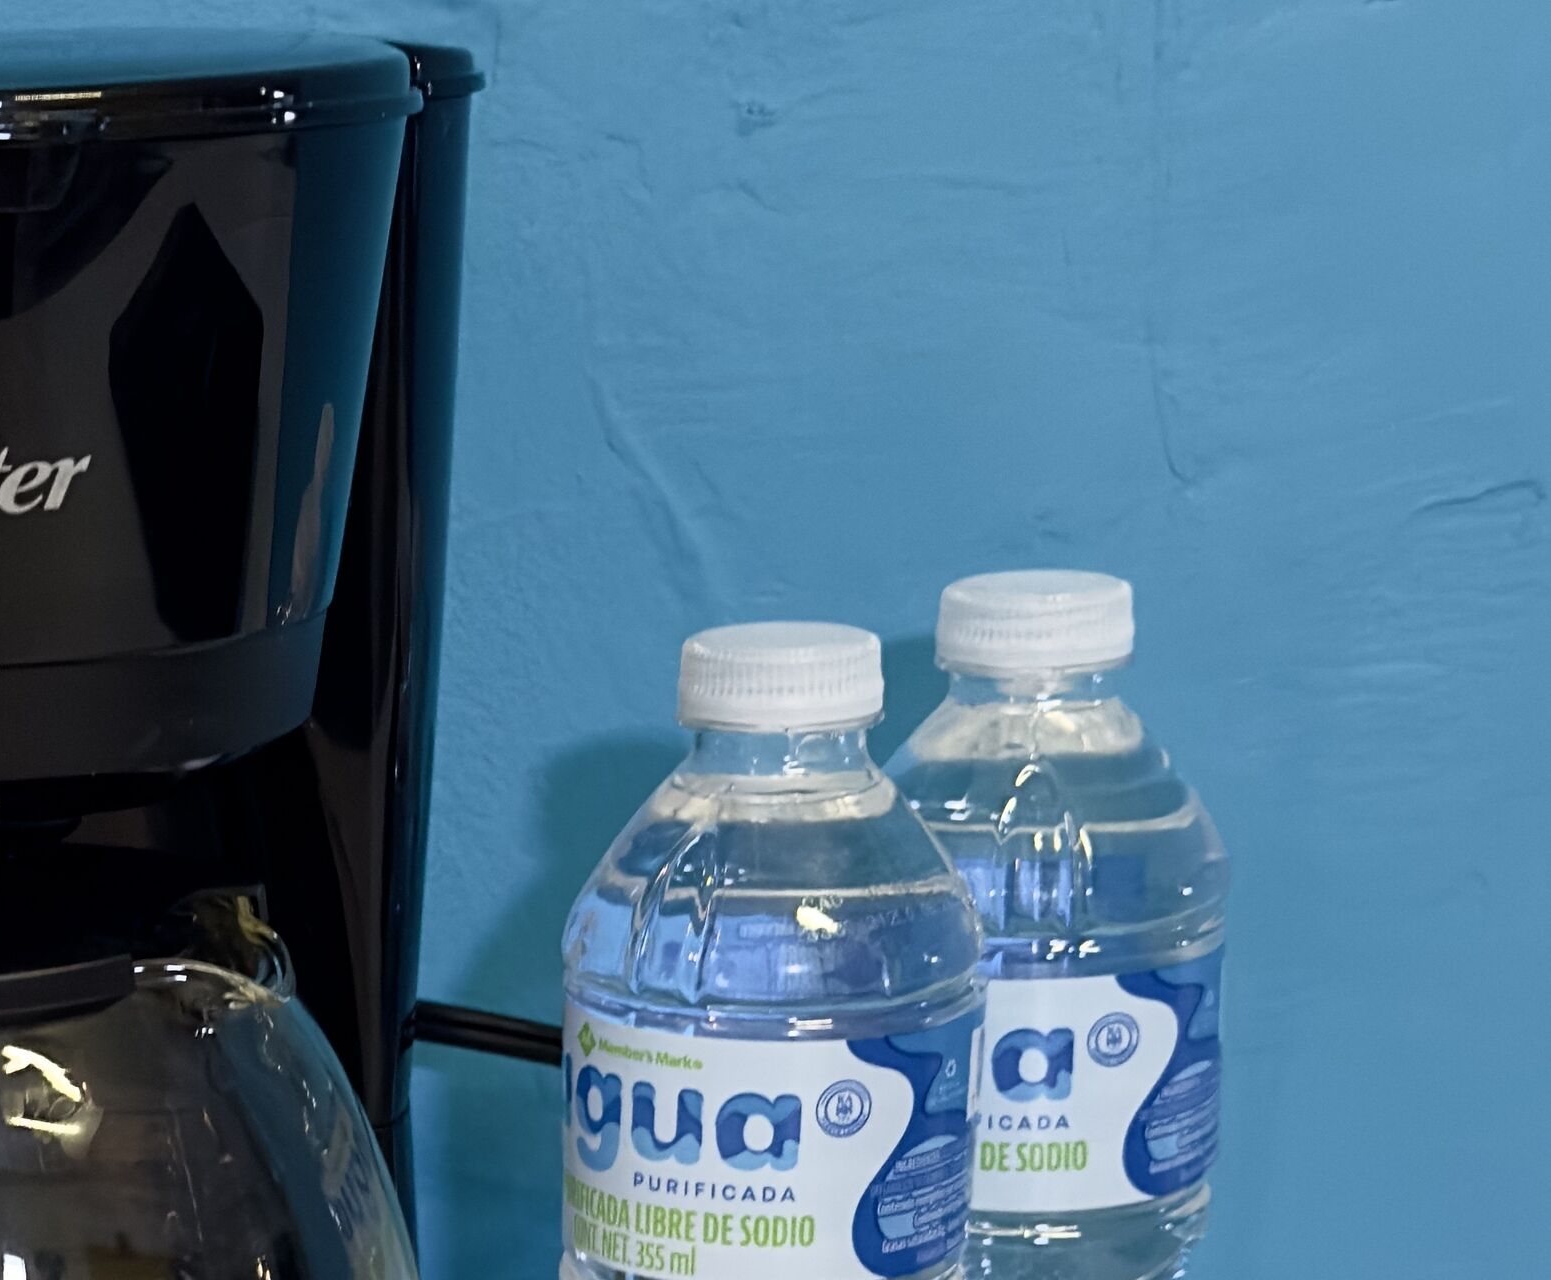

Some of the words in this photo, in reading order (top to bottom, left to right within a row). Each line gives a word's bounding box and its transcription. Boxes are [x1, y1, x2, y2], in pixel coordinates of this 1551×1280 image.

[562, 1051, 802, 1172] gua
[987, 1114, 1070, 1131] ICADA
[980, 1141, 1010, 1172] DE
[1015, 1140, 1087, 1172] SODIO
[633, 1172, 796, 1202] PURIFICADA
[635, 1201, 697, 1242] LIBRE
[702, 1212, 733, 1246] DE
[740, 1215, 816, 1248] SODIO
[635, 1240, 665, 1271] 355
[670, 1246, 696, 1276] ml
